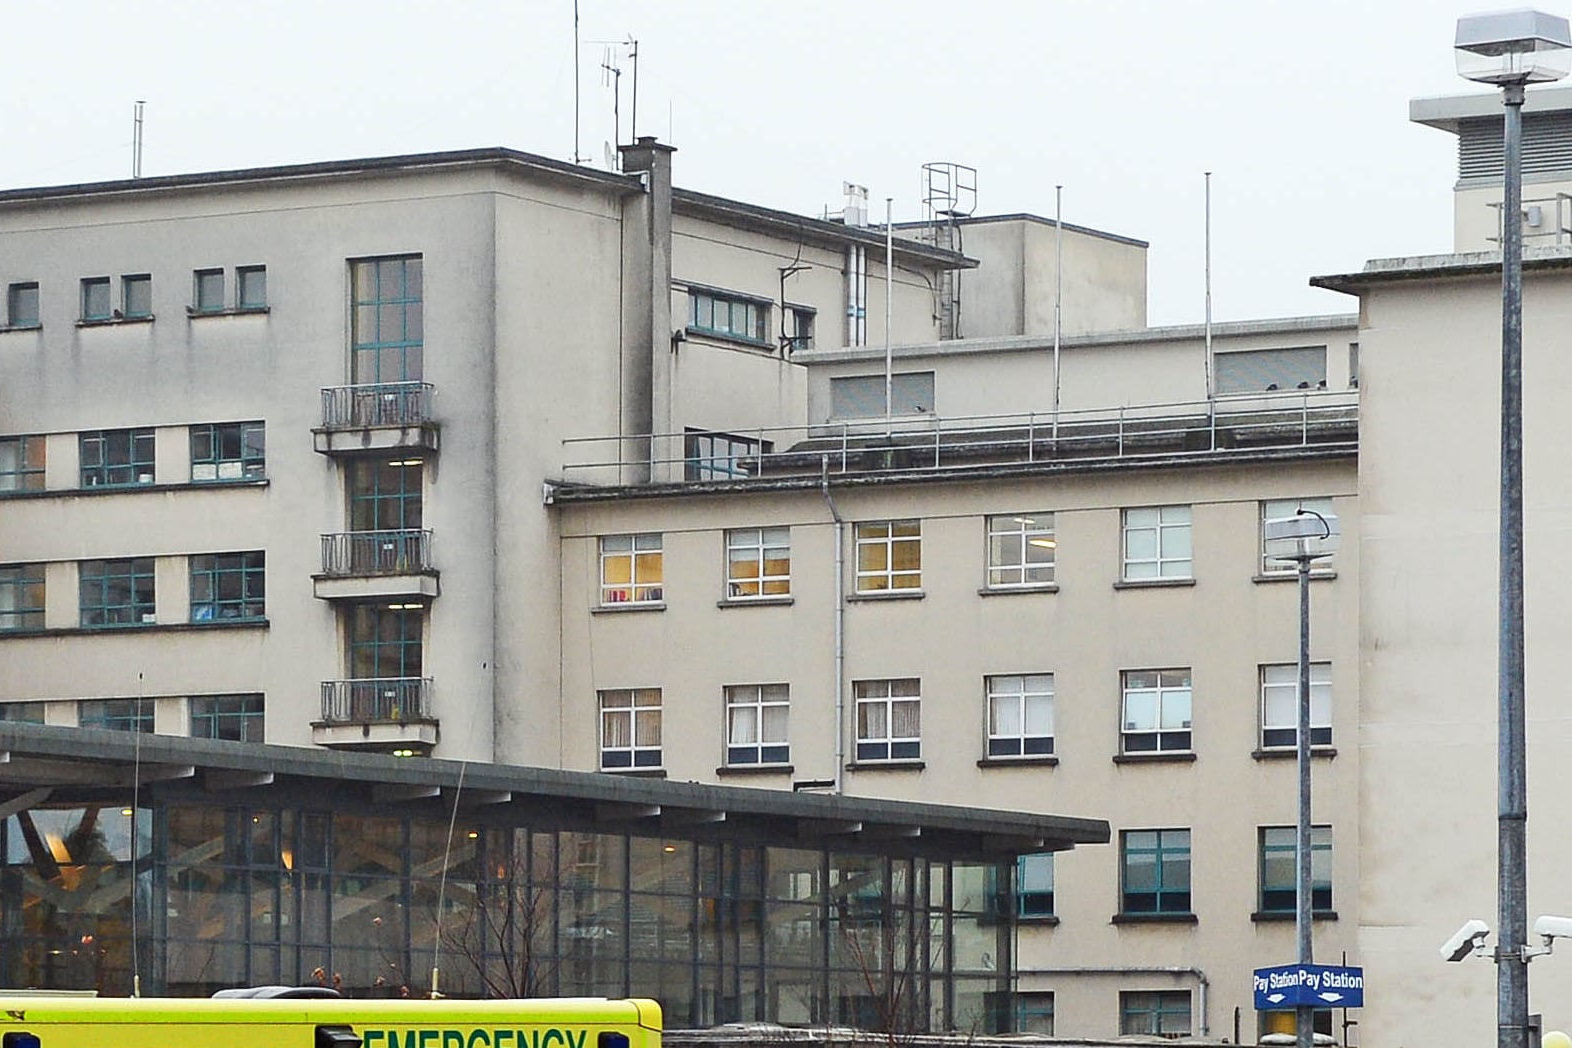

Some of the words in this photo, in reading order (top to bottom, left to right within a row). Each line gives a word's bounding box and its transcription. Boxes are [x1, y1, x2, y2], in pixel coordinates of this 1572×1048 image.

[1254, 973, 1269, 993] Pay
[1270, 971, 1298, 989] Station
[1299, 970, 1320, 991] Pay
[1322, 971, 1363, 989] Station
